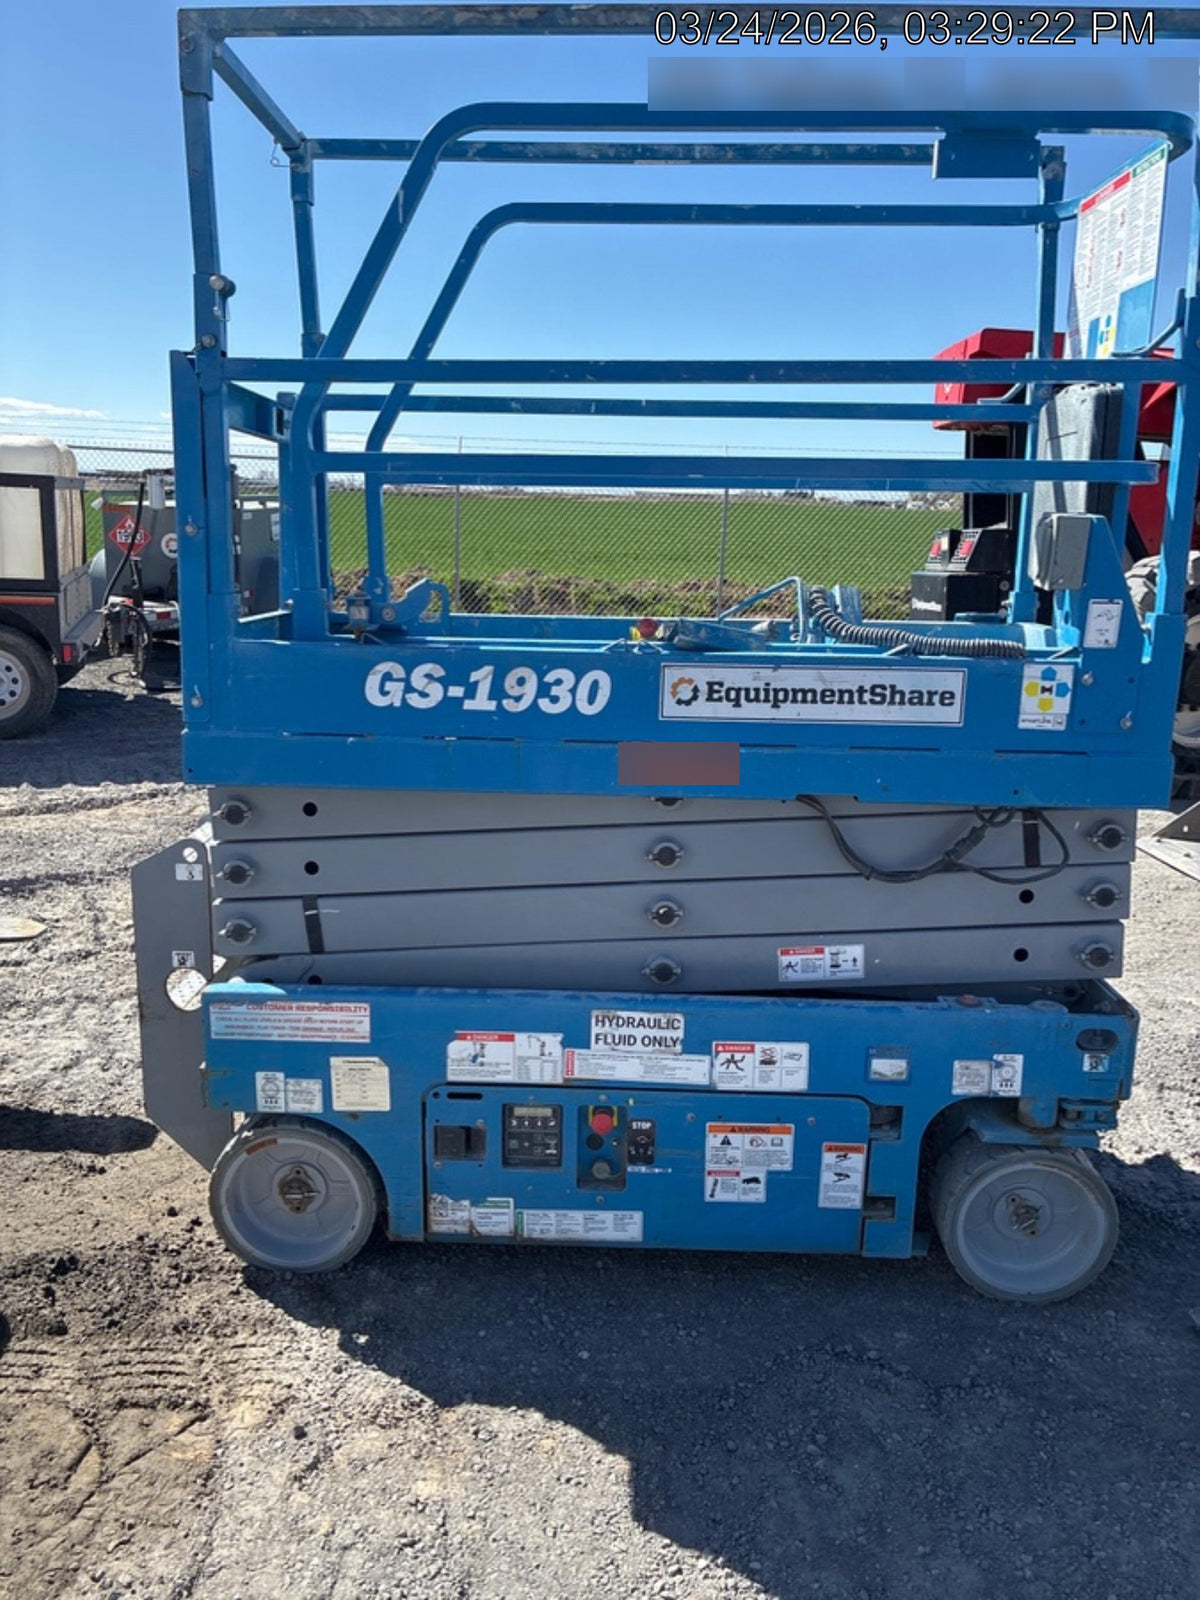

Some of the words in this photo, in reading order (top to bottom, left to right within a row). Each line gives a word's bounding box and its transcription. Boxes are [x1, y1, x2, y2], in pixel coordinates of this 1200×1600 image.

[117, 529, 144, 543] 193
[364, 661, 613, 716] GS-1930
[705, 681, 956, 708] EquipmentShare
[246, 1002, 294, 1011] CUSTOMER
[295, 1003, 368, 1013] RESPONSIBILITY
[594, 1014, 682, 1031] HYDRAULIC
[594, 1032, 638, 1048] FLUID
[640, 1034, 682, 1050] ONLY
[631, 1121, 652, 1131] STOP
[737, 1126, 770, 1134] WARNING
